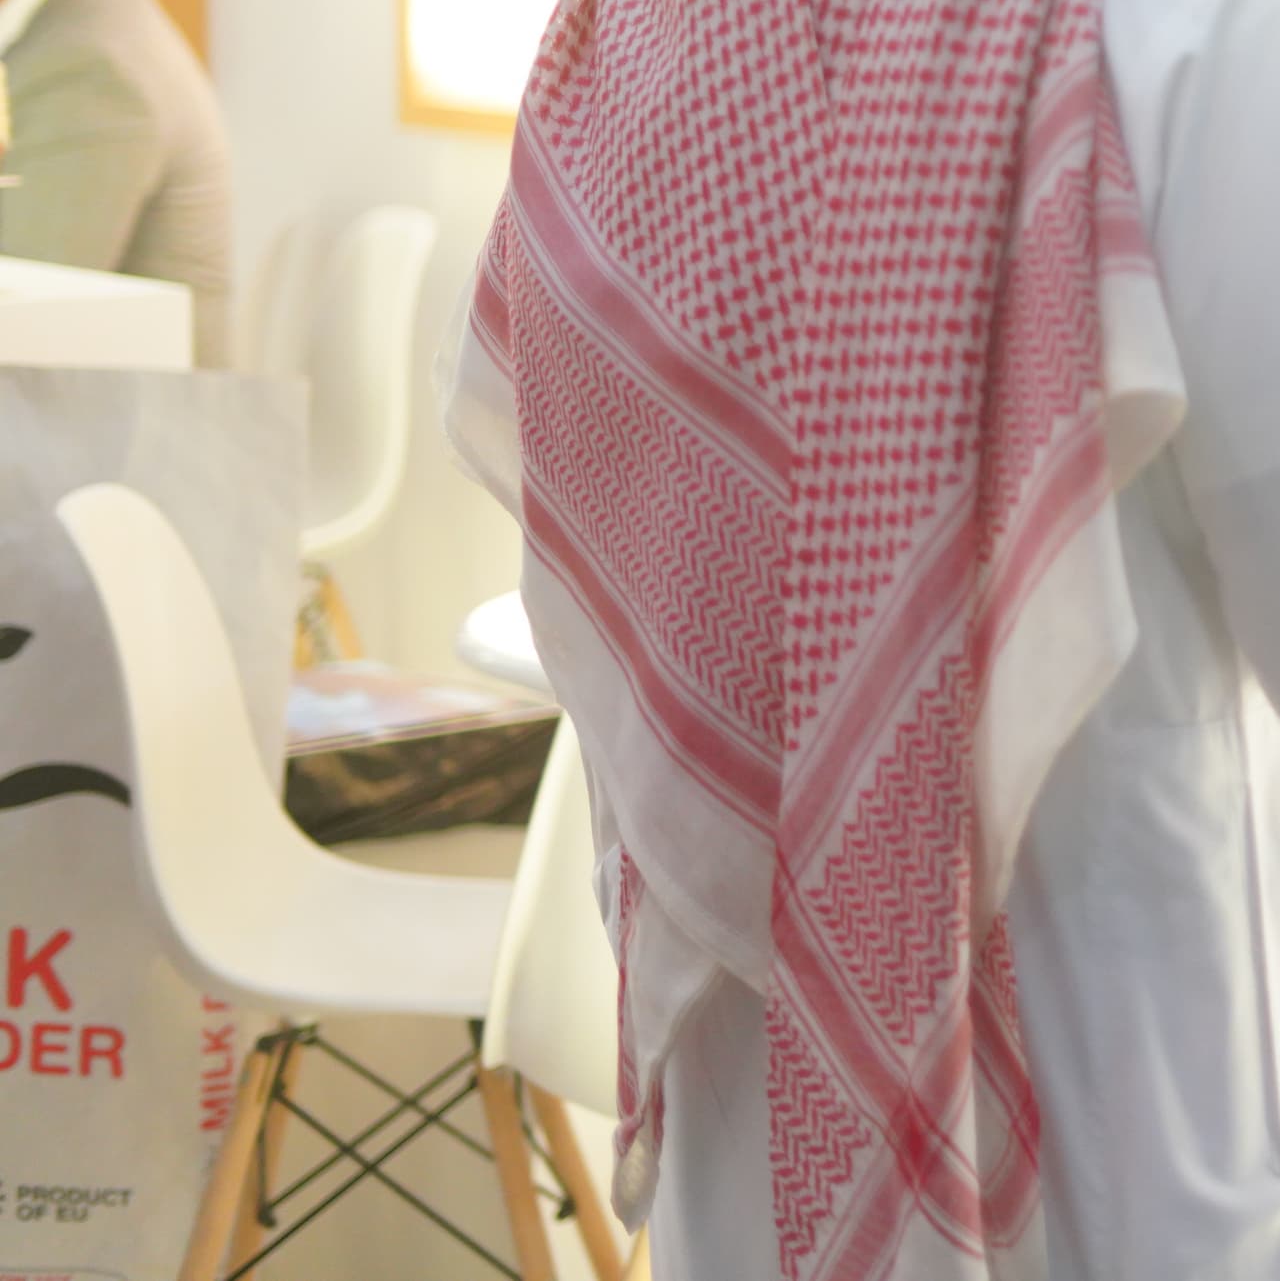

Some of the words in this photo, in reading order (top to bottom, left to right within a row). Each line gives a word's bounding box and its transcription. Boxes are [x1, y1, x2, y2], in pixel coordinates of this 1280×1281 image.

[200, 1023, 236, 1131] MILK
[16, 1185, 132, 1207] PRODUCT
[55, 1203, 90, 1224] EU
